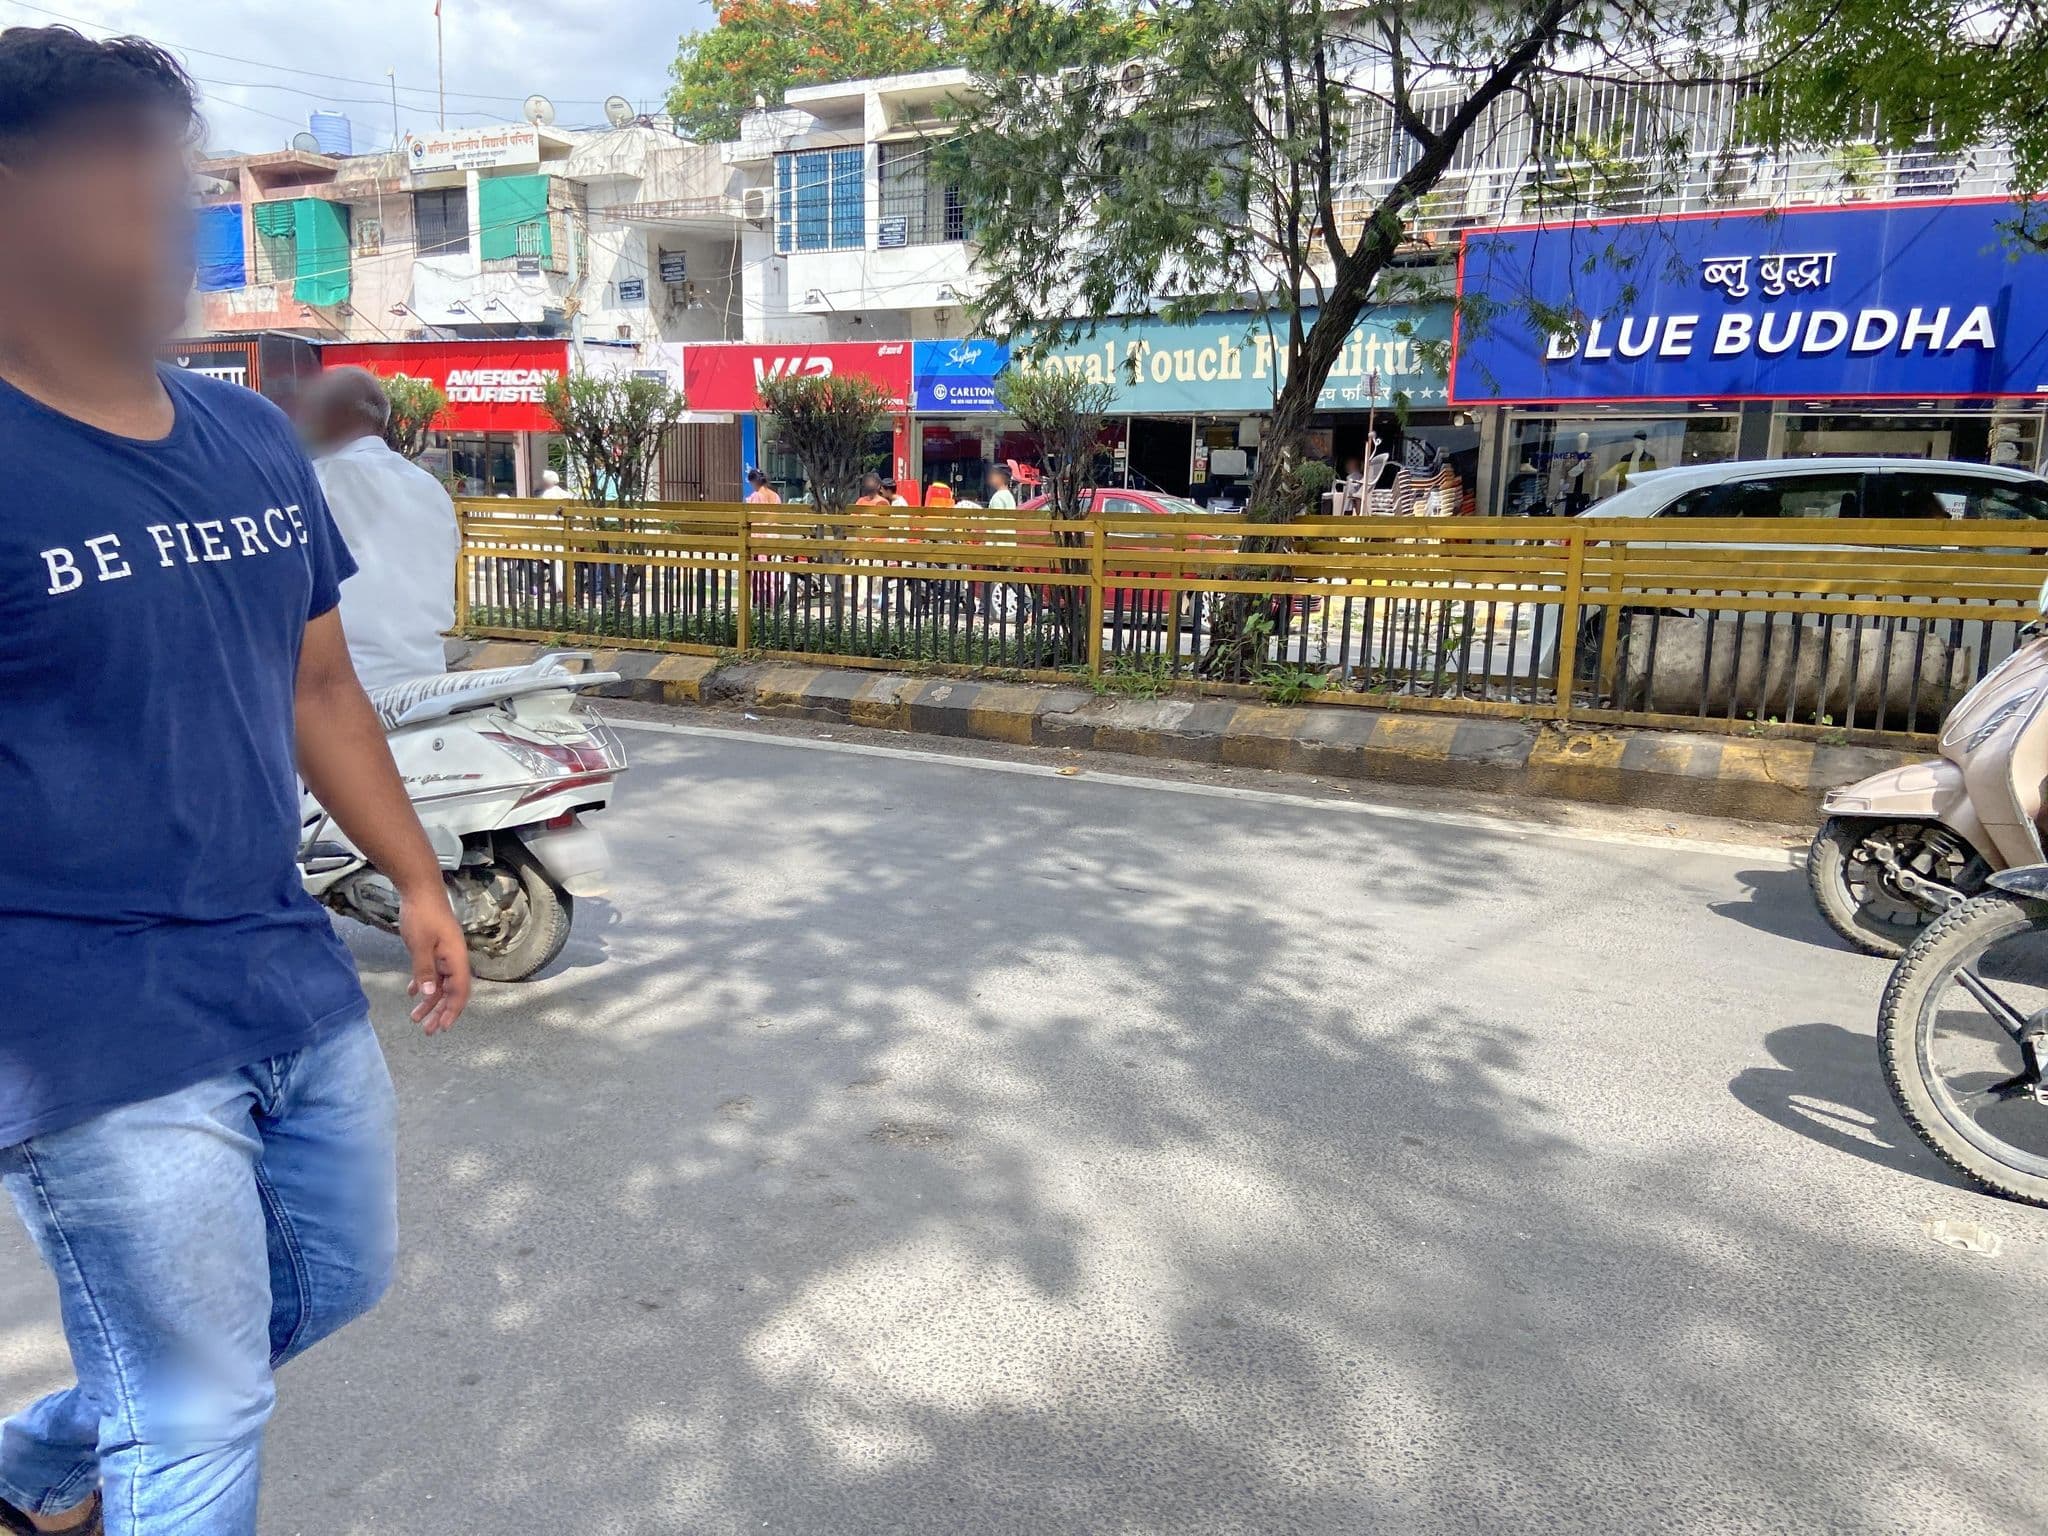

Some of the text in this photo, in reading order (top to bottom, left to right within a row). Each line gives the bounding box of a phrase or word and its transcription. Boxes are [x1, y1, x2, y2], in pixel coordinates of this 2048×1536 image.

[1702, 252, 1837, 297] ब्लु बुद्धा
[1713, 306, 1996, 354] BUDDHA
[1126, 335, 1242, 383] Touch
[950, 387, 995, 397] CARLTON
[40, 504, 309, 595] BE FIERCE
